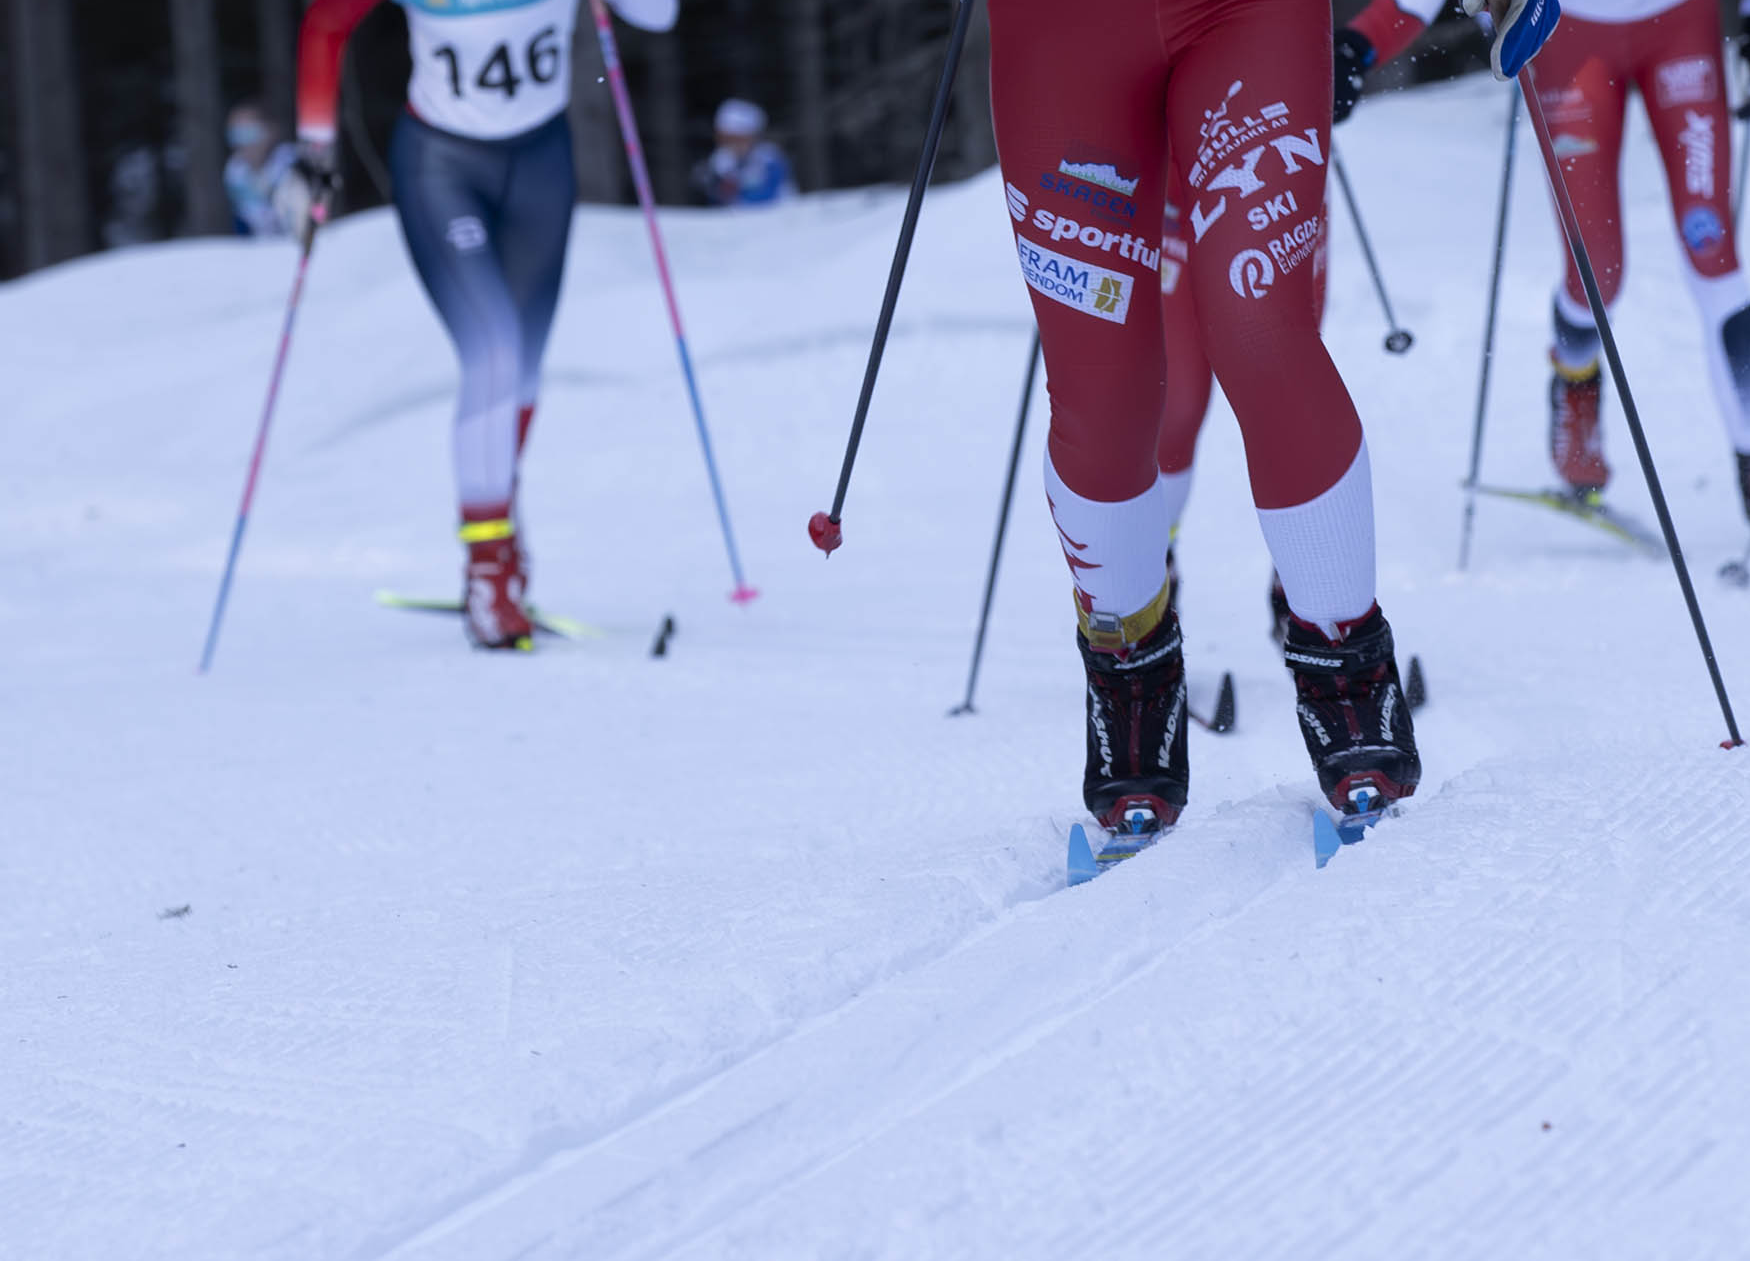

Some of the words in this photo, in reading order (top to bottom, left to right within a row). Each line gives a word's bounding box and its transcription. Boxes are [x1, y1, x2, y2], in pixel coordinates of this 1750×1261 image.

[434, 26, 562, 100] 146
[1190, 127, 1325, 243] LYN
[1247, 190, 1299, 231] SKI
[1019, 243, 1090, 289] FRAM
[1032, 208, 1161, 272] sportful
